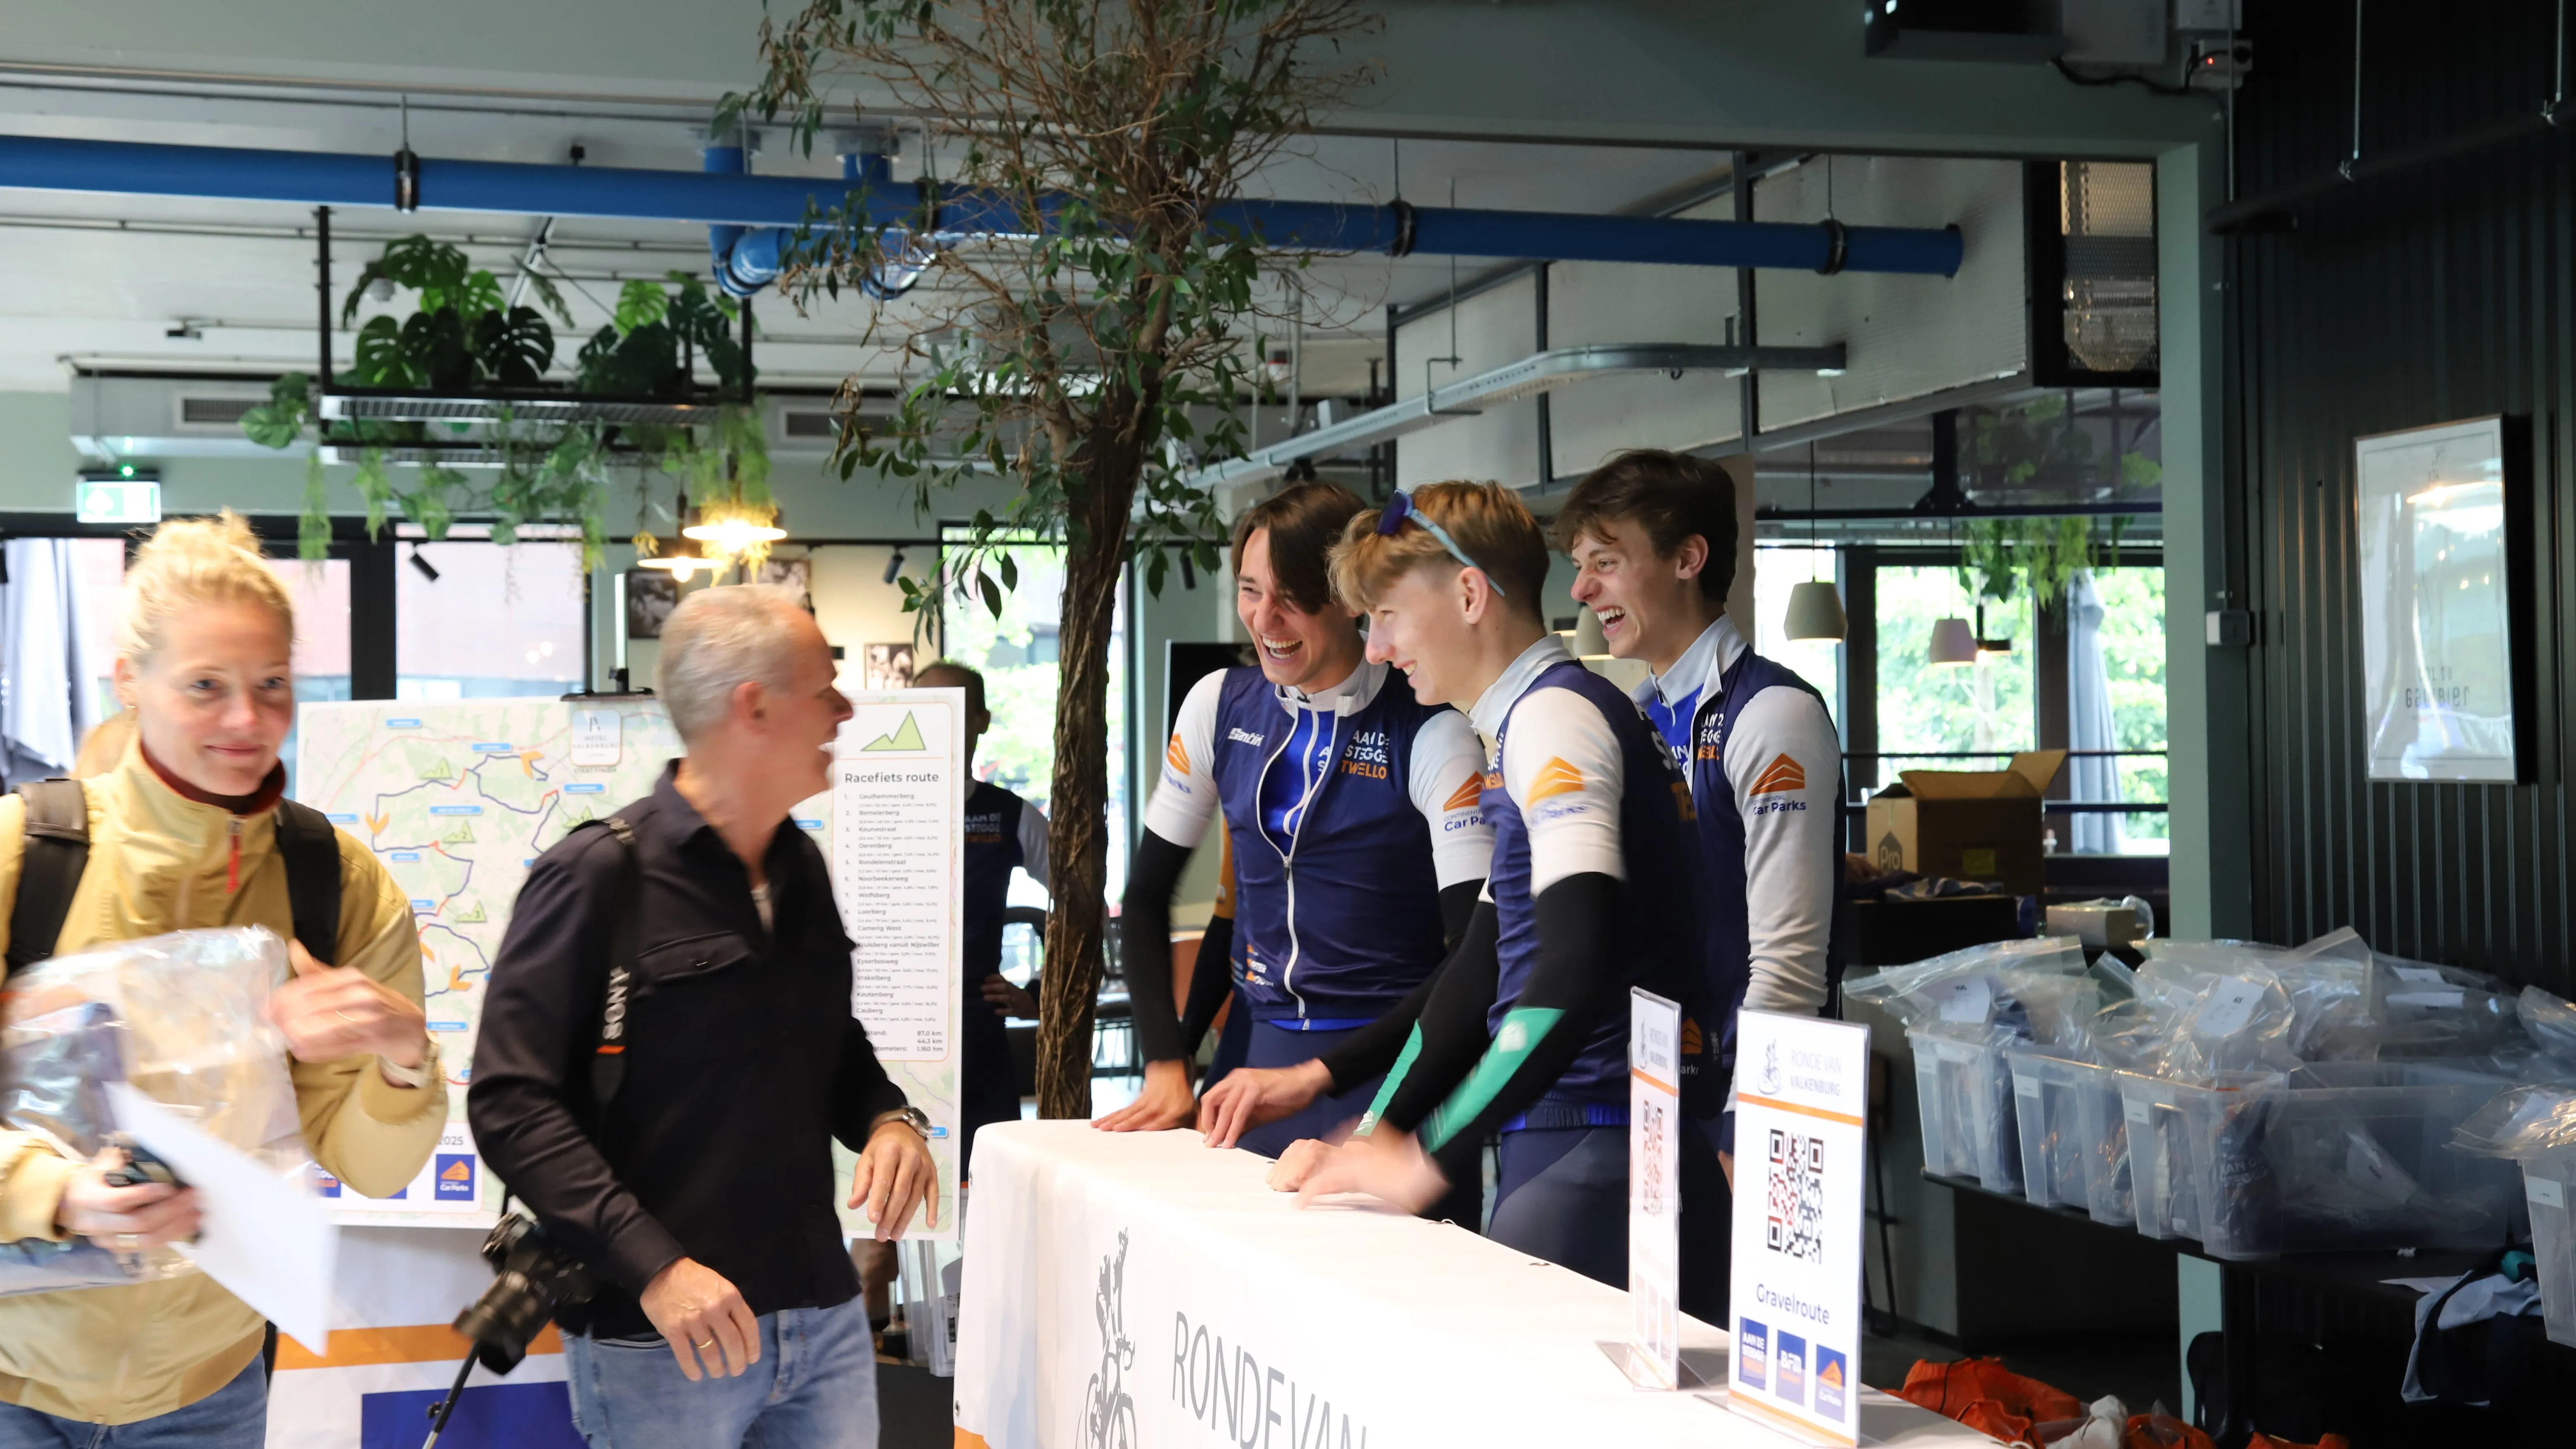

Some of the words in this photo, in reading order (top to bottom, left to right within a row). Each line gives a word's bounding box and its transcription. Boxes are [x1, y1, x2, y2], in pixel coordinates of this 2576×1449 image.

[1341, 760, 1387, 779] TWELLO
[845, 772, 902, 784] Racefiets
[906, 773, 939, 783] route
[1771, 800, 1806, 812] Parks
[1444, 818, 1468, 831] Car
[475, 910, 480, 919] 3
[602, 965, 630, 1039] SONY
[1681, 1064, 1699, 1075] arks
[1790, 1074, 1841, 1098] VALKENBURG
[1757, 1283, 1830, 1325] Gravelroute
